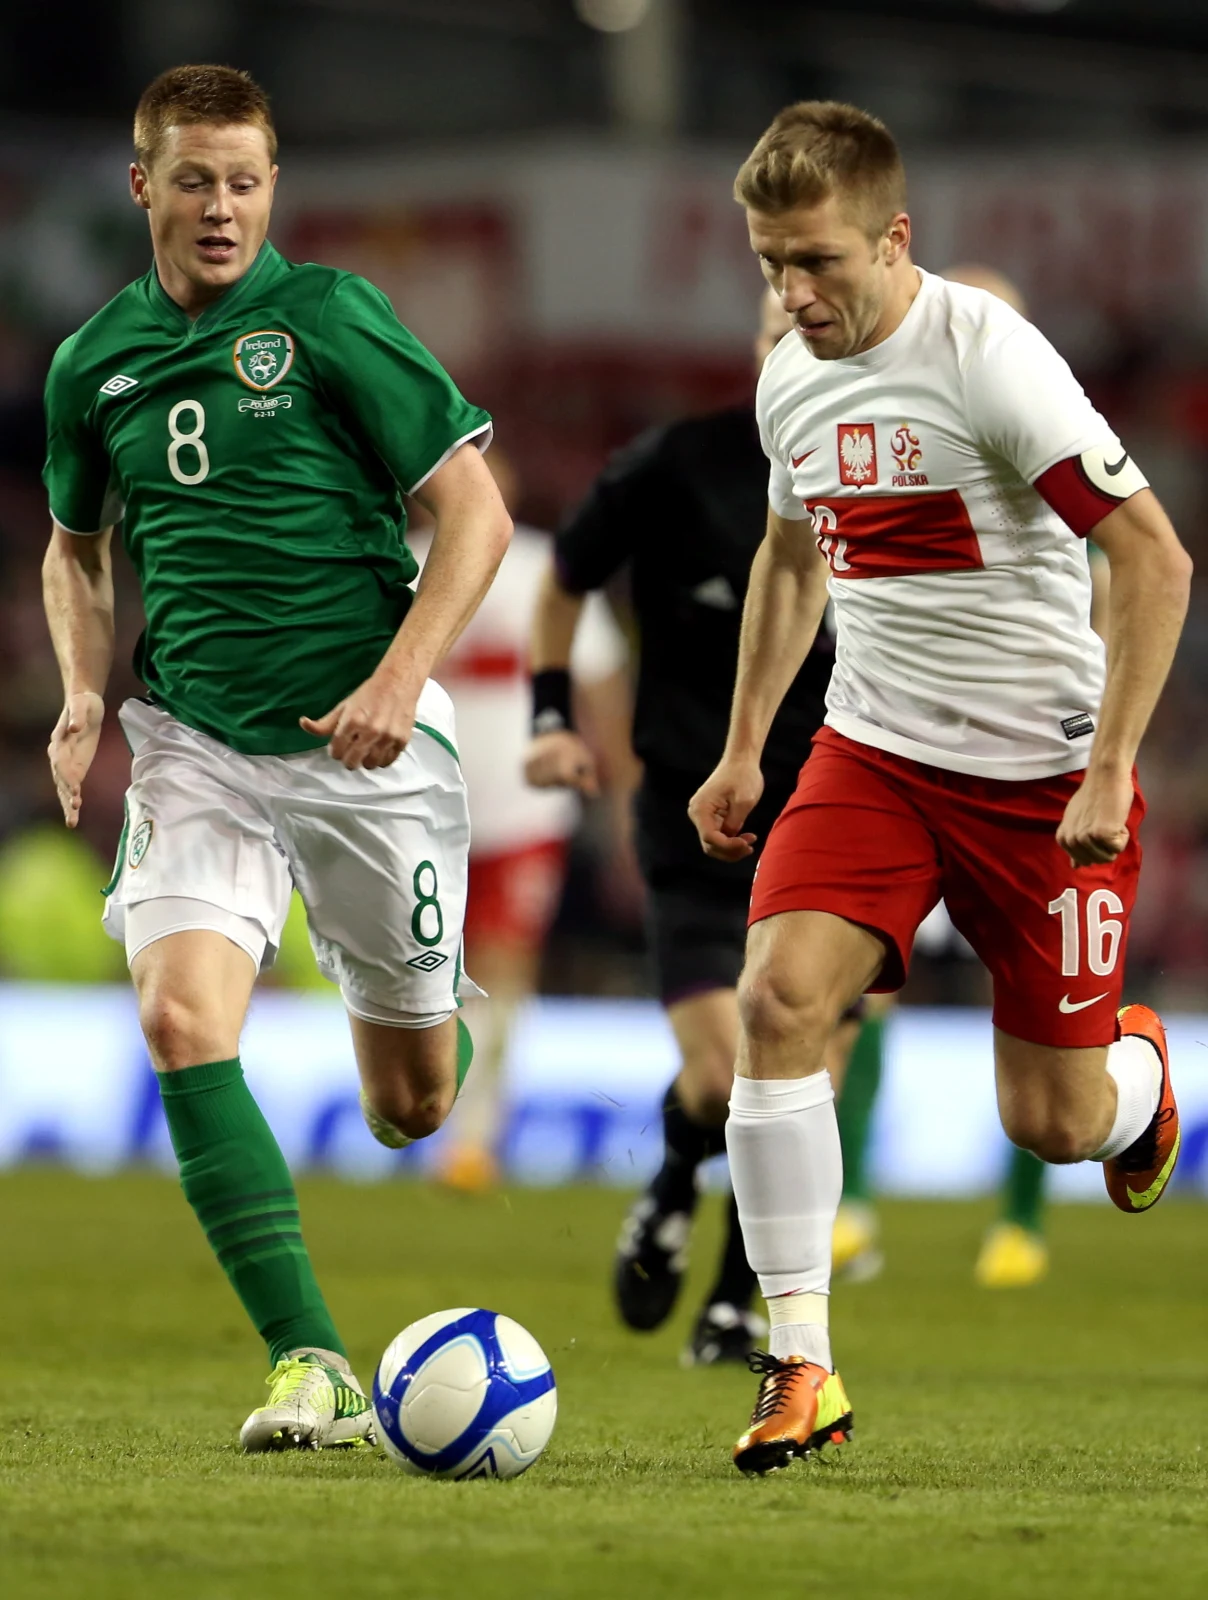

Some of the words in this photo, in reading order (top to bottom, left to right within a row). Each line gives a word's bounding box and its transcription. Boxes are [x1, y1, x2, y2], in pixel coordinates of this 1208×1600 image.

[245, 339, 281, 350] Ireland
[250, 399, 279, 409] POLAND
[167, 399, 210, 486] 8
[892, 474, 929, 487] POLSKA
[411, 860, 444, 947] 8
[1048, 887, 1124, 977] 16
